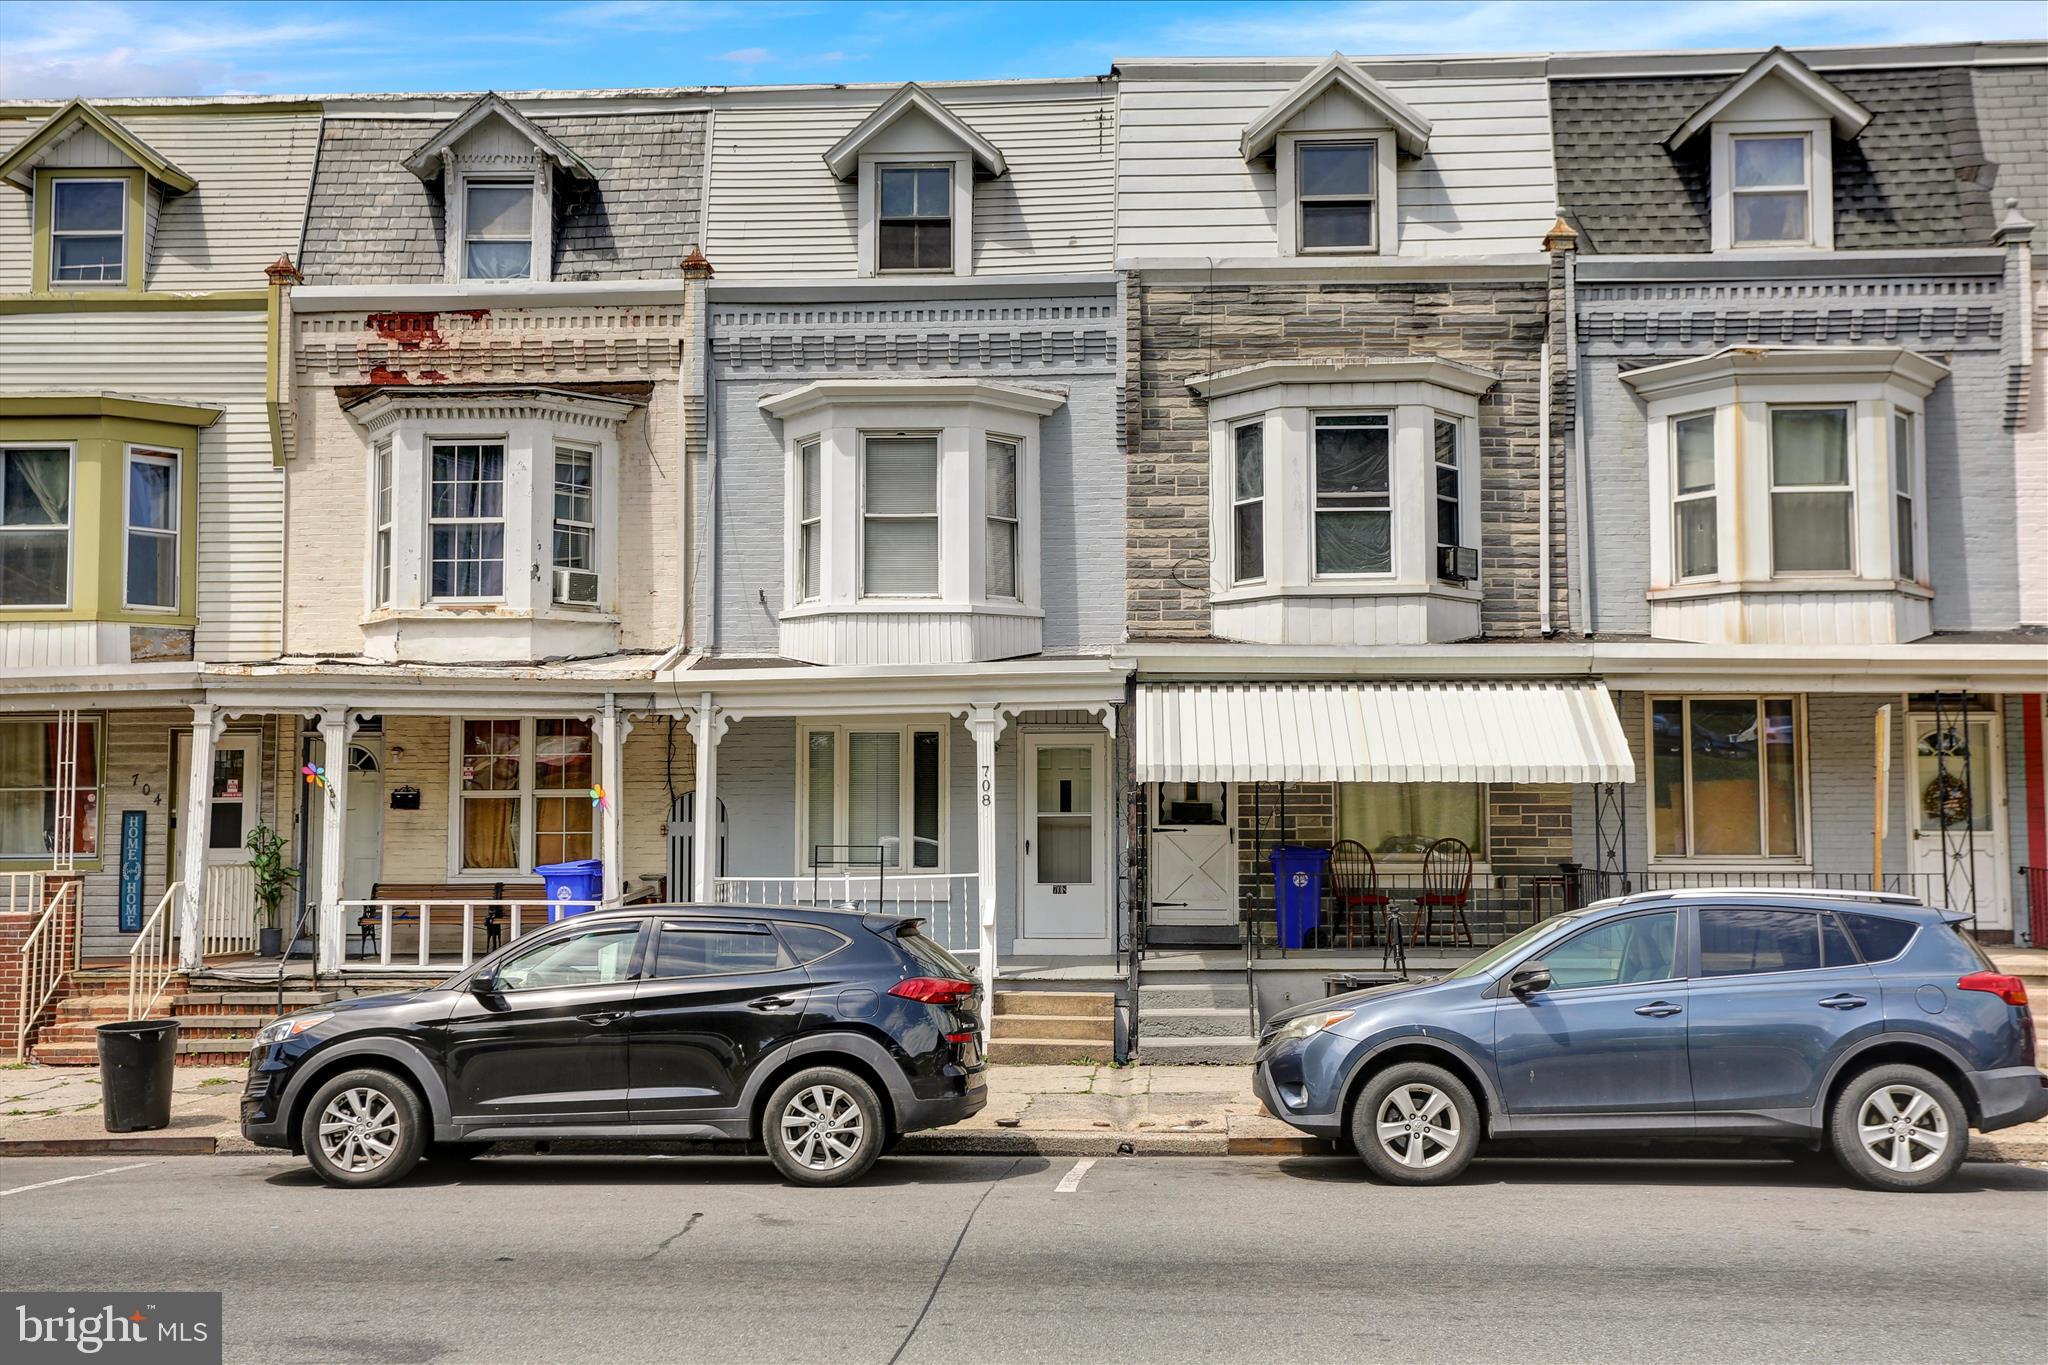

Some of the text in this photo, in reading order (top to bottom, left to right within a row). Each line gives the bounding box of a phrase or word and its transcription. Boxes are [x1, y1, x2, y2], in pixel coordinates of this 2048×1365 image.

[131, 773, 162, 806] 704
[982, 765, 991, 806] 708
[127, 816, 139, 860] HOME
[126, 882, 137, 927] HOME
